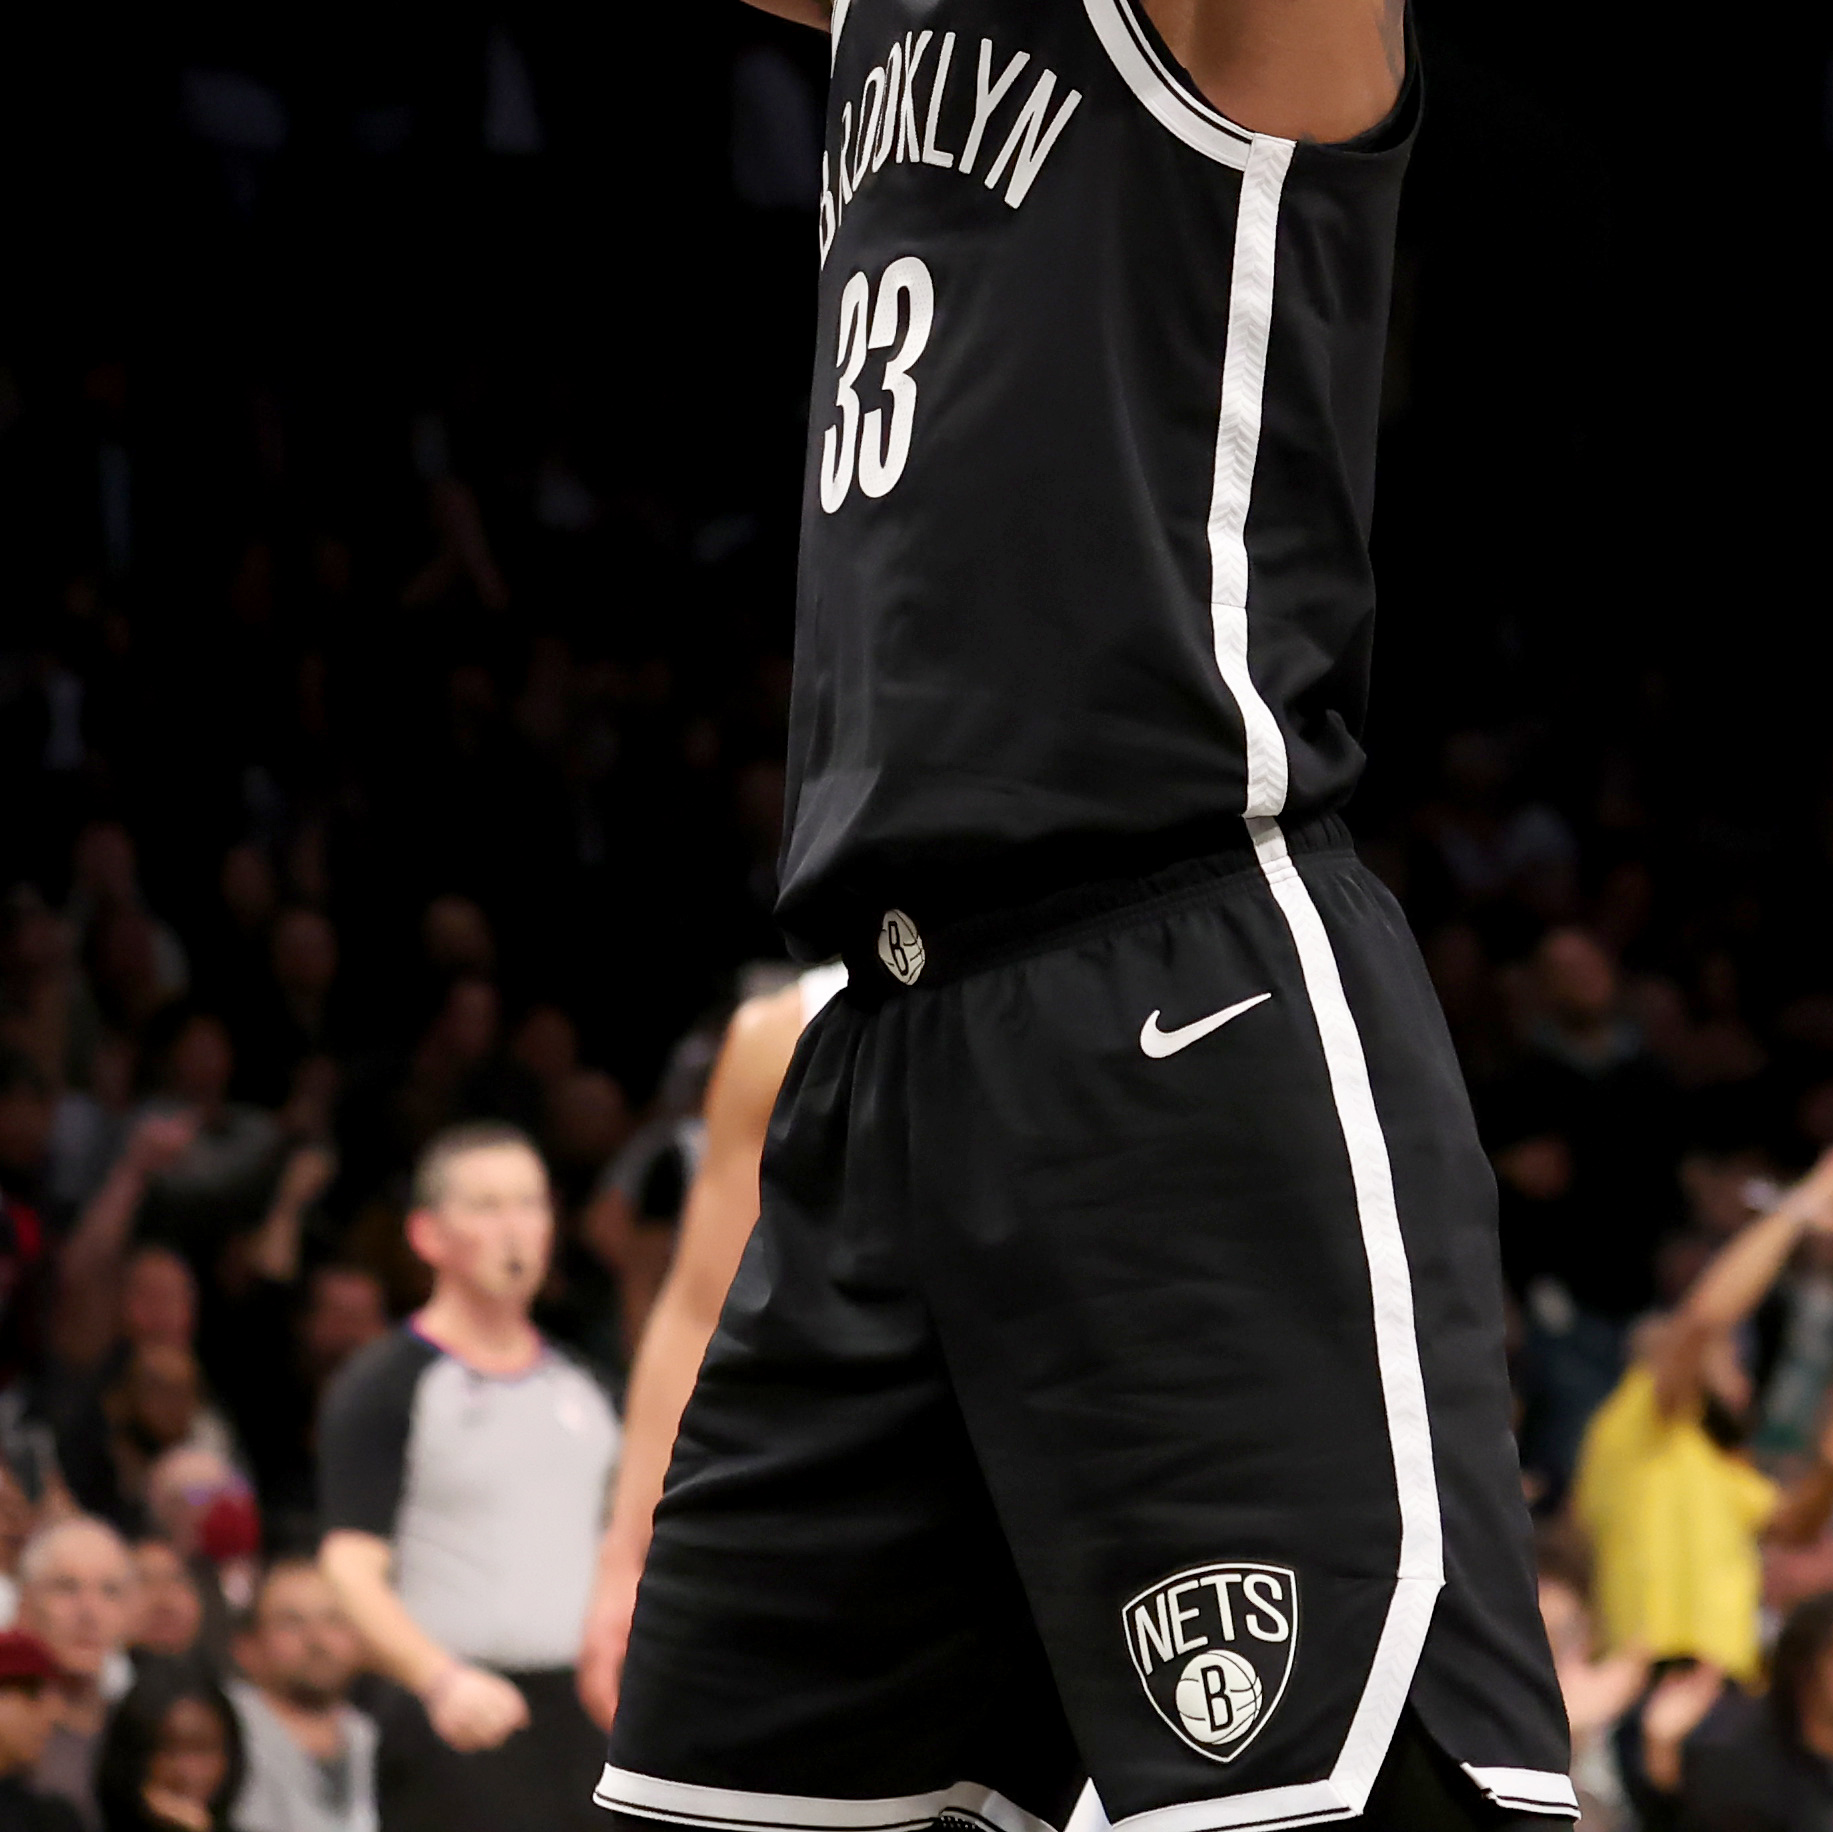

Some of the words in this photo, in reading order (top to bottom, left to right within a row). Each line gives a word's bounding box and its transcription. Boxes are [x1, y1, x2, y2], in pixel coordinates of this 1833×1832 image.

[818, 29, 1083, 271] BROOKLYN
[819, 256, 935, 514] 33
[1134, 1573, 1290, 1676] NETS
[1200, 1664, 1234, 1733] B
